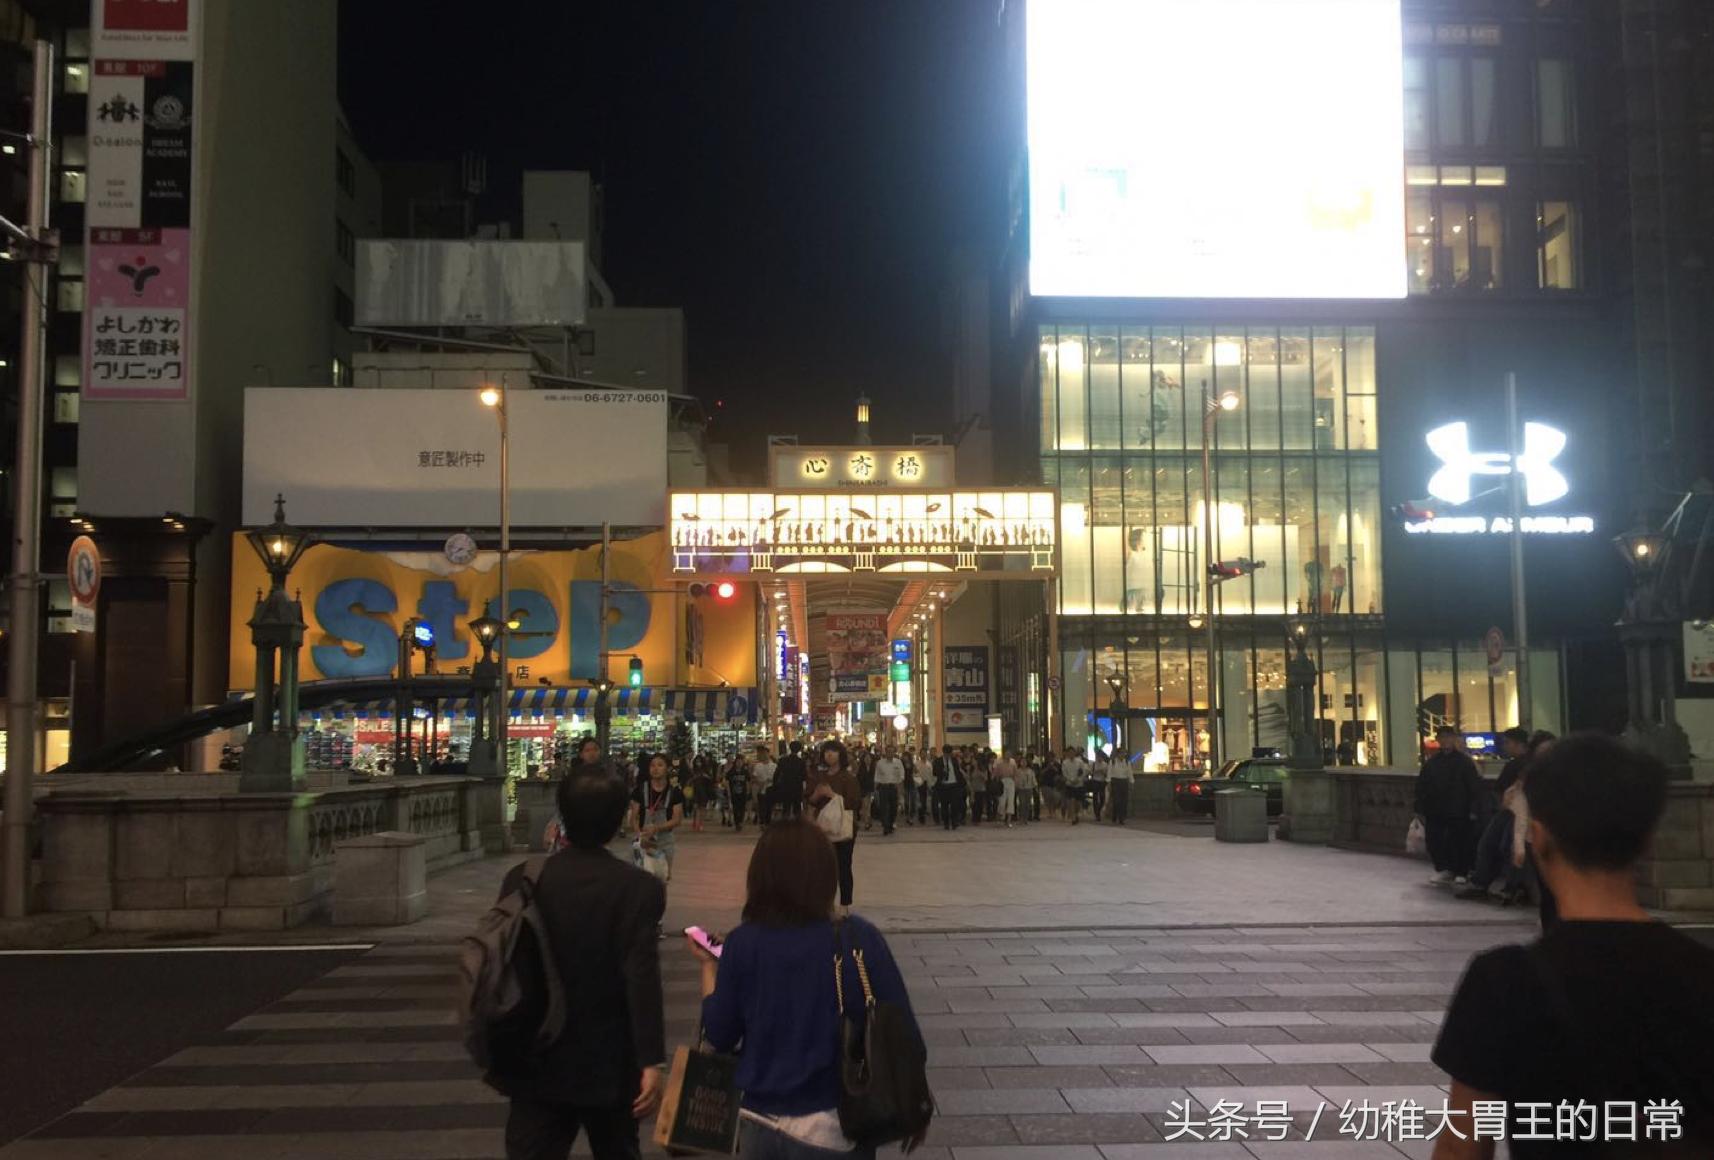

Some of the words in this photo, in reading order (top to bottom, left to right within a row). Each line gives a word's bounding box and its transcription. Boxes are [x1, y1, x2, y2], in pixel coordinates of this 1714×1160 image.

[95, 315, 180, 334] よしかわ
[94, 338, 180, 357] 矯正歯科
[92, 361, 182, 381] クリニック
[584, 392, 666, 403] 06-6727-0601
[417, 450, 485, 468] 意匠製作中
